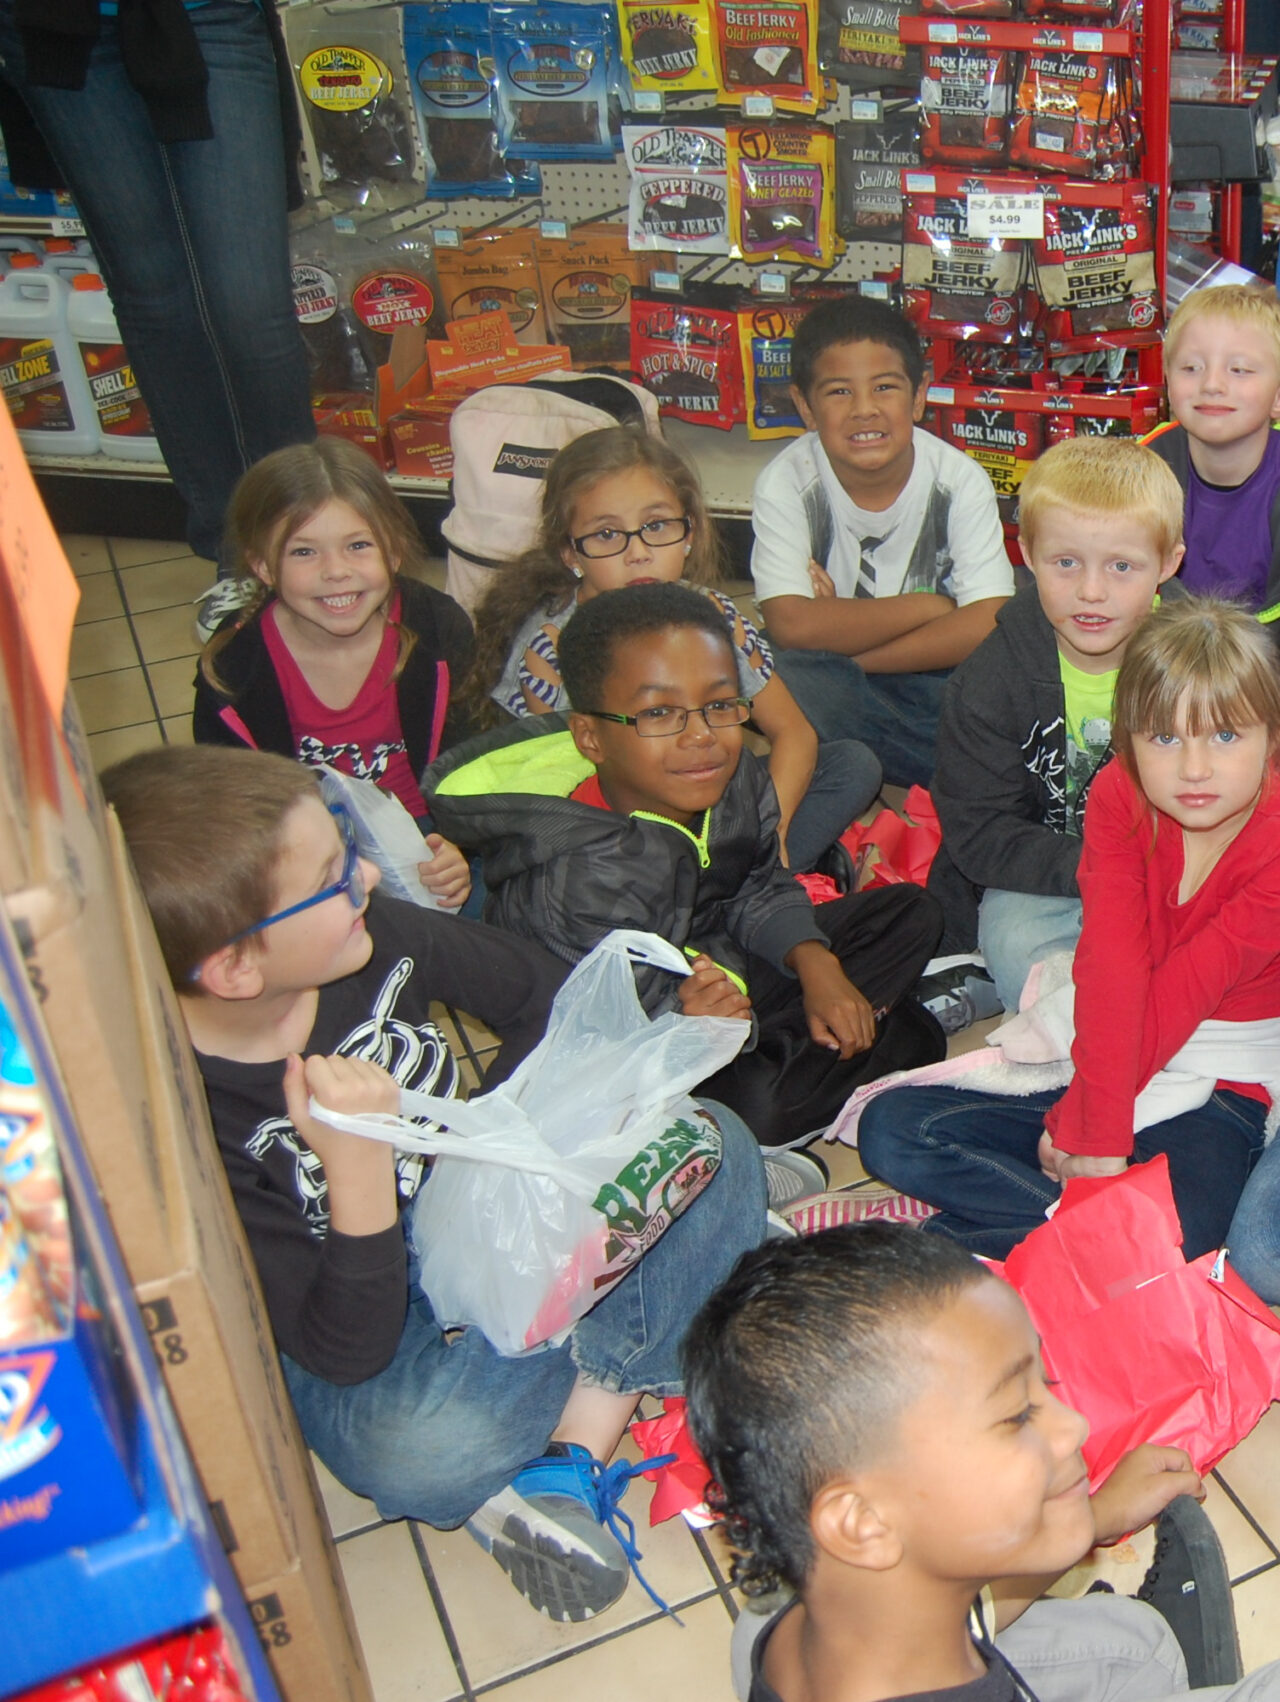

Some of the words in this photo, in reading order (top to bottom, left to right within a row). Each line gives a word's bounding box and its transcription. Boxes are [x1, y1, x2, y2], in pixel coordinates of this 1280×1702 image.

[726, 9, 755, 26] BEEF
[757, 12, 796, 28] JERKY
[841, 6, 875, 26] Small
[725, 26, 743, 41] Old
[745, 27, 800, 40] Fashioned
[634, 56, 663, 76] BEEF
[661, 48, 698, 71] JERKY
[929, 55, 957, 69] JACK
[959, 57, 998, 71] LINK'S
[1030, 58, 1058, 72] JACK
[1058, 63, 1098, 79] LINK'S
[311, 87, 335, 100] BEEF
[337, 86, 372, 99] JERKY
[941, 87, 985, 98] BEEF
[936, 98, 990, 110] JERKY
[632, 135, 661, 164] OLD
[853, 148, 880, 162] JACK
[882, 150, 920, 165] LINK'S
[778, 172, 814, 187] JERKY
[854, 169, 884, 191] Small
[883, 169, 901, 190] Bat
[641, 179, 726, 201] PEPPERED
[778, 187, 815, 199] GLAZED
[970, 199, 1041, 211] SALE
[644, 220, 677, 234] BEEF
[681, 216, 725, 234] JERKY
[918, 215, 955, 233] JACK
[989, 215, 1021, 225] $4.99
[1046, 230, 1084, 251] JACK
[1086, 224, 1137, 245] LINK'S
[931, 259, 992, 275] BEEF
[1072, 255, 1118, 269] ORIGINAL
[924, 272, 999, 289] JERKY
[1067, 268, 1126, 288] BEEF
[951, 288, 986, 297] PROTEIN
[1062, 279, 1133, 302] JERKY
[365, 311, 393, 328] BEEF
[394, 306, 428, 322] JERKY
[641, 353, 669, 376] HOT
[671, 352, 681, 370] &
[682, 353, 717, 383] SPICY
[756, 364, 769, 377] SEA
[769, 363, 785, 378] SALT
[93, 367, 136, 398] SHELLZ
[677, 395, 720, 411] JERKY
[952, 422, 983, 440] JACK
[985, 427, 1028, 446] LINK'S
[497, 452, 552, 470] JANSPOR
[973, 451, 1009, 463] TERIYAKI
[163, 1333, 189, 1365] 8
[270, 1620, 292, 1648] 8
